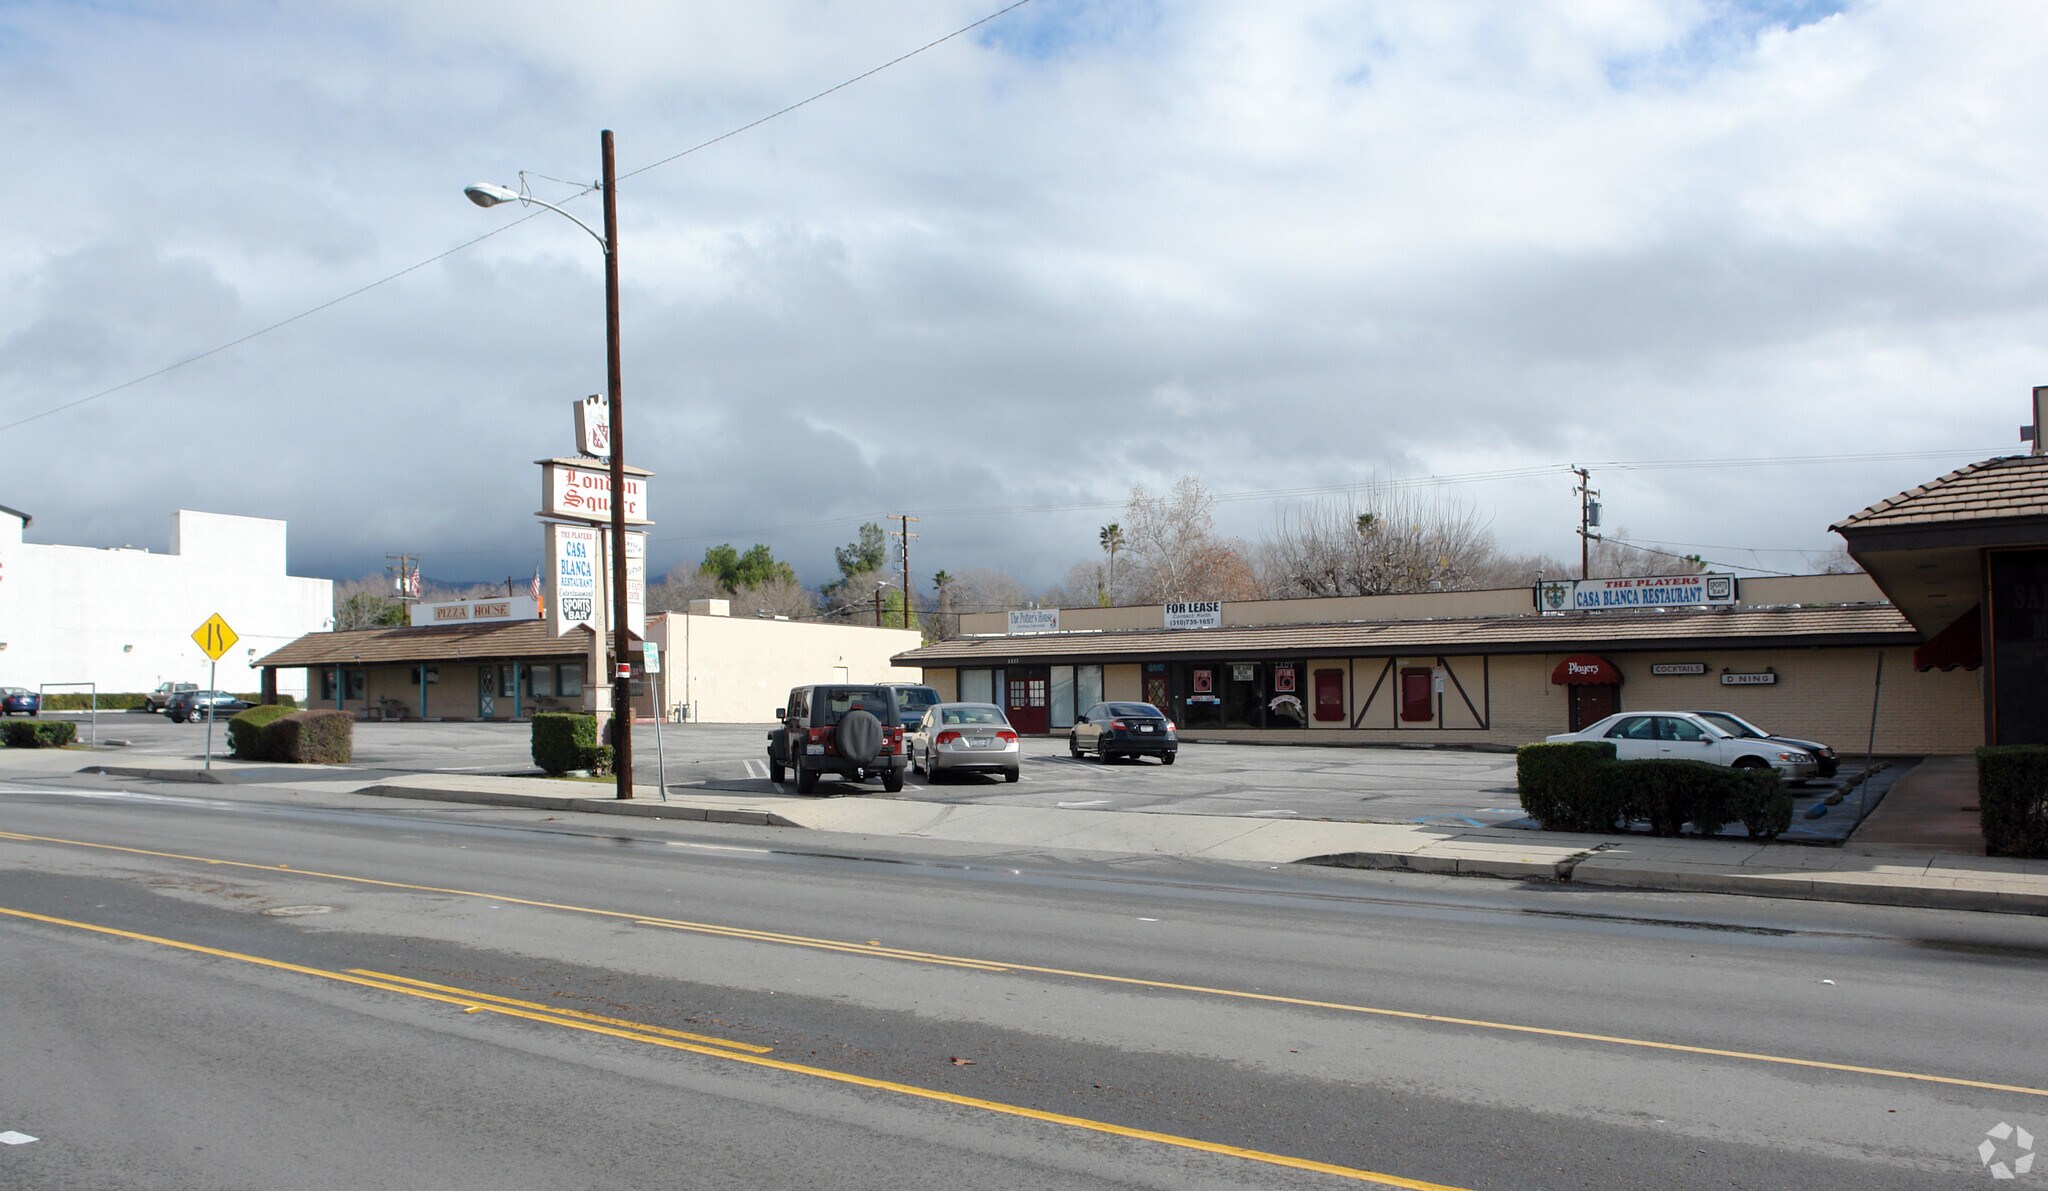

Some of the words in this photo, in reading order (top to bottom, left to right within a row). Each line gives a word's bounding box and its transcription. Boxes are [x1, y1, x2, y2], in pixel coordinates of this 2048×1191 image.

[565, 468, 637, 494] Londn
[563, 489, 636, 513] Sque
[561, 531, 570, 539] THE
[571, 532, 592, 540] PLAYERS
[566, 541, 586, 558] CASA
[561, 559, 591, 577] BLANCA
[561, 577, 593, 587] RESTAURANT
[1636, 577, 1699, 586] PLAYERS
[1709, 581, 1727, 590] SPORTS
[1577, 591, 1600, 607] CASA
[1603, 590, 1639, 606] BLANCA
[1642, 587, 1702, 604] RESTAURANT
[437, 607, 466, 619] PIZZA
[474, 604, 507, 616] HOUSE
[563, 599, 591, 612] SPORTS
[1166, 603, 1186, 614] FOR
[1188, 602, 1219, 613] LEASE
[568, 611, 587, 620] BAR
[1010, 612, 1019, 624] The
[1568, 662, 1599, 675] Players
[1655, 665, 1701, 673] COCKTAILS
